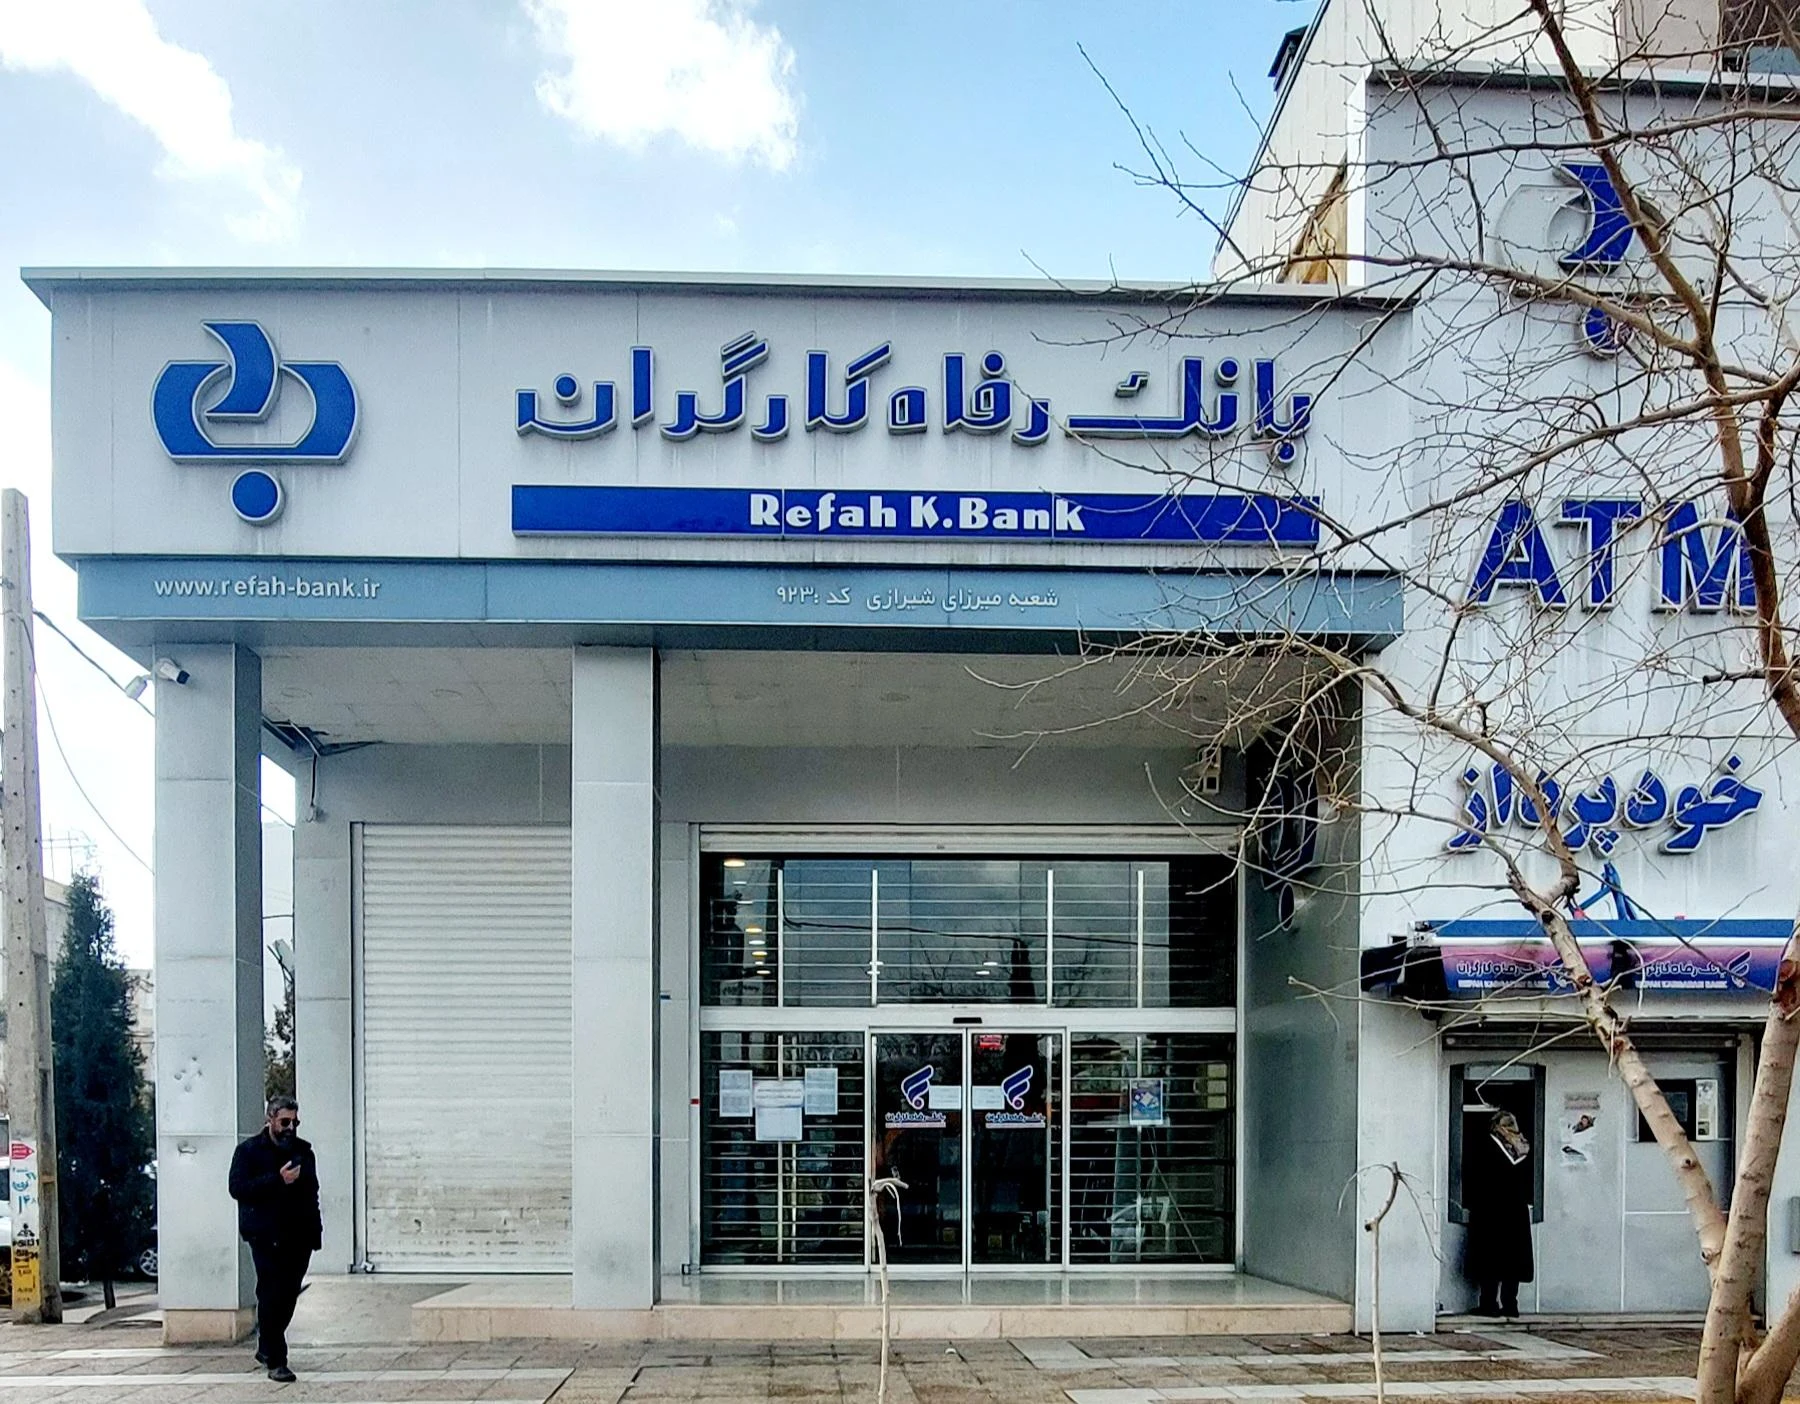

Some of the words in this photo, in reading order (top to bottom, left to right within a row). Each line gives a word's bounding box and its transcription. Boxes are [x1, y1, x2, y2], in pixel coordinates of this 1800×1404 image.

[515, 330, 891, 442] کارگران
[888, 350, 1051, 445] رفاه
[1065, 355, 1313, 464] بانک
[750, 492, 897, 532] Refah
[910, 495, 1086, 532] K.Bank
[1465, 499, 1758, 608] ATM
[154, 575, 381, 598] www.refah-bank.ir
[826, 587, 851, 604] کد
[866, 587, 935, 610] شیرازی
[942, 587, 1001, 611] میرزای
[1008, 588, 1058, 611] شعبه
